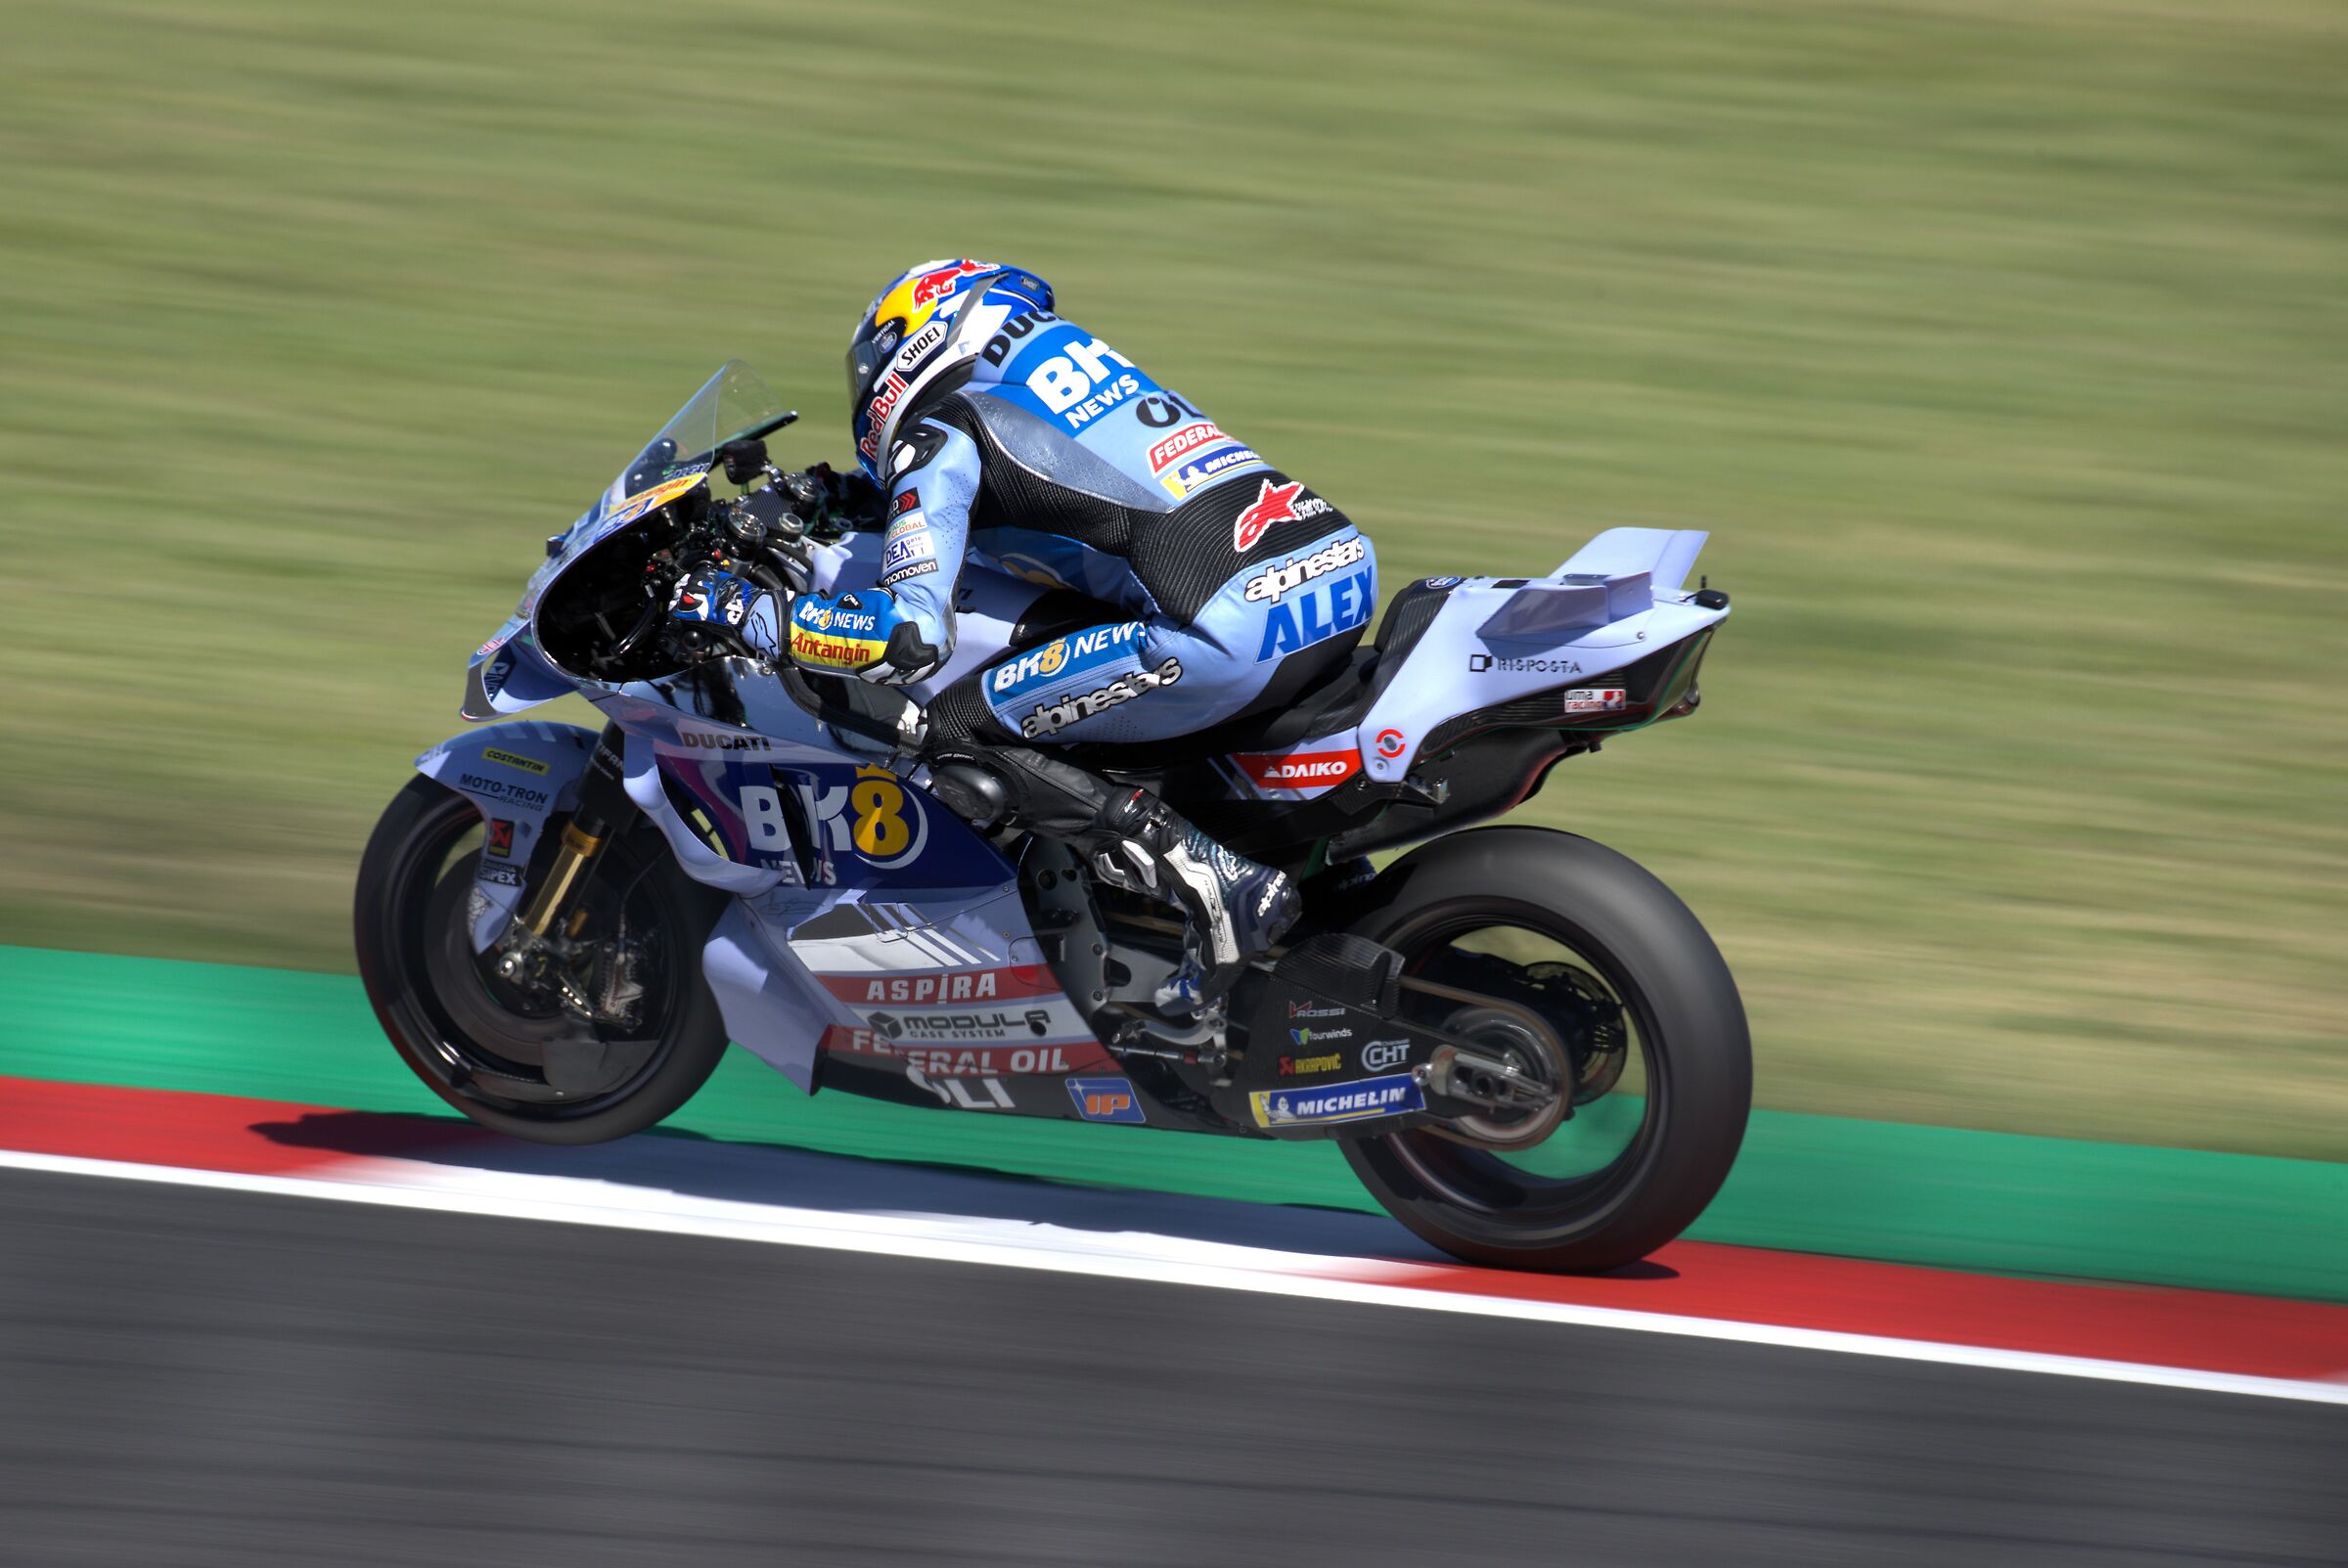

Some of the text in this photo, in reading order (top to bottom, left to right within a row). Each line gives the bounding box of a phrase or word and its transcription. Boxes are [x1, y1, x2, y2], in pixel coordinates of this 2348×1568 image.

[901, 326, 941, 366] SHOEI
[871, 373, 910, 424] Bull
[1065, 374, 1140, 428] NEWS
[891, 522, 925, 539] GLOBAL
[884, 561, 936, 586] momoven
[1243, 537, 1366, 604] alpinestars
[833, 612, 876, 632] NEWS
[1255, 564, 1373, 663] ALEX
[791, 632, 870, 663] Antangin
[994, 637, 1069, 693] BK8
[1497, 658, 1583, 674] RISPOSTA
[1020, 656, 1183, 739] alpinestars
[680, 732, 772, 752] DUCATI
[1280, 760, 1347, 779] DAIKO
[459, 774, 549, 805] MOTO-TRON
[498, 795, 544, 812] RACING
[739, 780, 910, 856] BK8
[866, 972, 997, 1005] ASPIRA
[903, 1008, 1051, 1031] MODULA
[910, 1028, 1007, 1039] CASE SYSTEM
[1309, 1028, 1353, 1041] fourwinds
[852, 1030, 1070, 1075] FEERAL OIL
[1370, 1044, 1411, 1064] CHT
[1086, 1095, 1131, 1116] IP
[1296, 1088, 1407, 1116] MICHELIN
